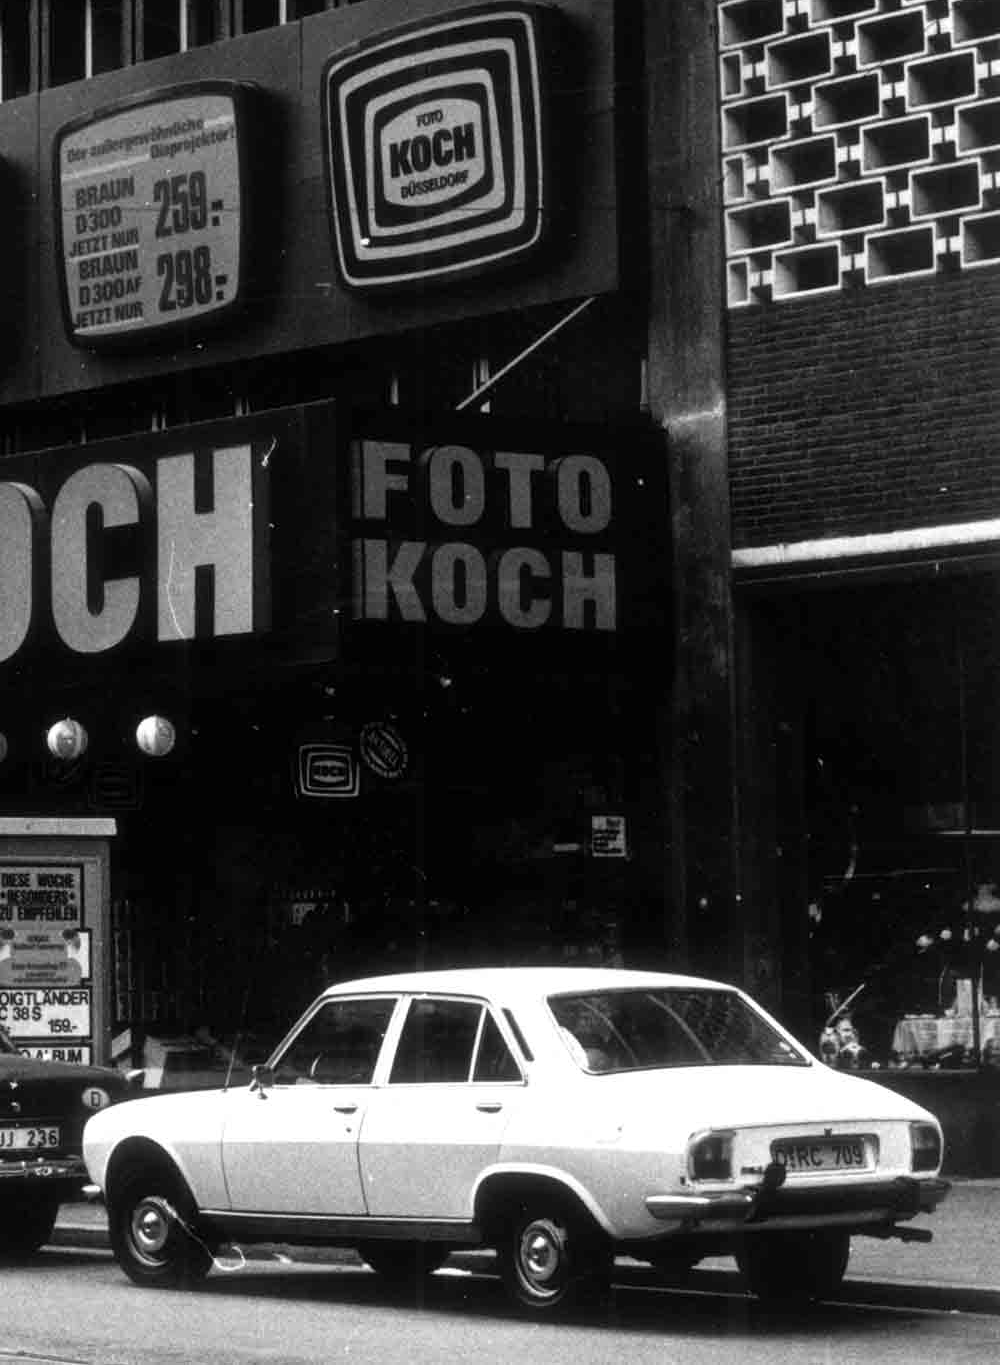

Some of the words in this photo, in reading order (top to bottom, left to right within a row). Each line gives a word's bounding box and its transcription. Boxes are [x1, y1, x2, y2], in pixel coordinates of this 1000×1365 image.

[416, 109, 443, 127] FOTO
[389, 121, 476, 179] KOCH
[75, 175, 135, 209] BRAUN
[400, 169, 469, 200] DÜSSELDORF
[69, 235, 112, 257] JETZT
[111, 228, 140, 249] NUR
[79, 249, 139, 281] BRAUN
[73, 307, 113, 328] JETZT
[114, 301, 144, 320] NUR
[358, 439, 612, 533] FOTO
[358, 537, 617, 631] KOCH
[91, 1091, 102, 1107] D
[27, 1130, 58, 1146] 236
